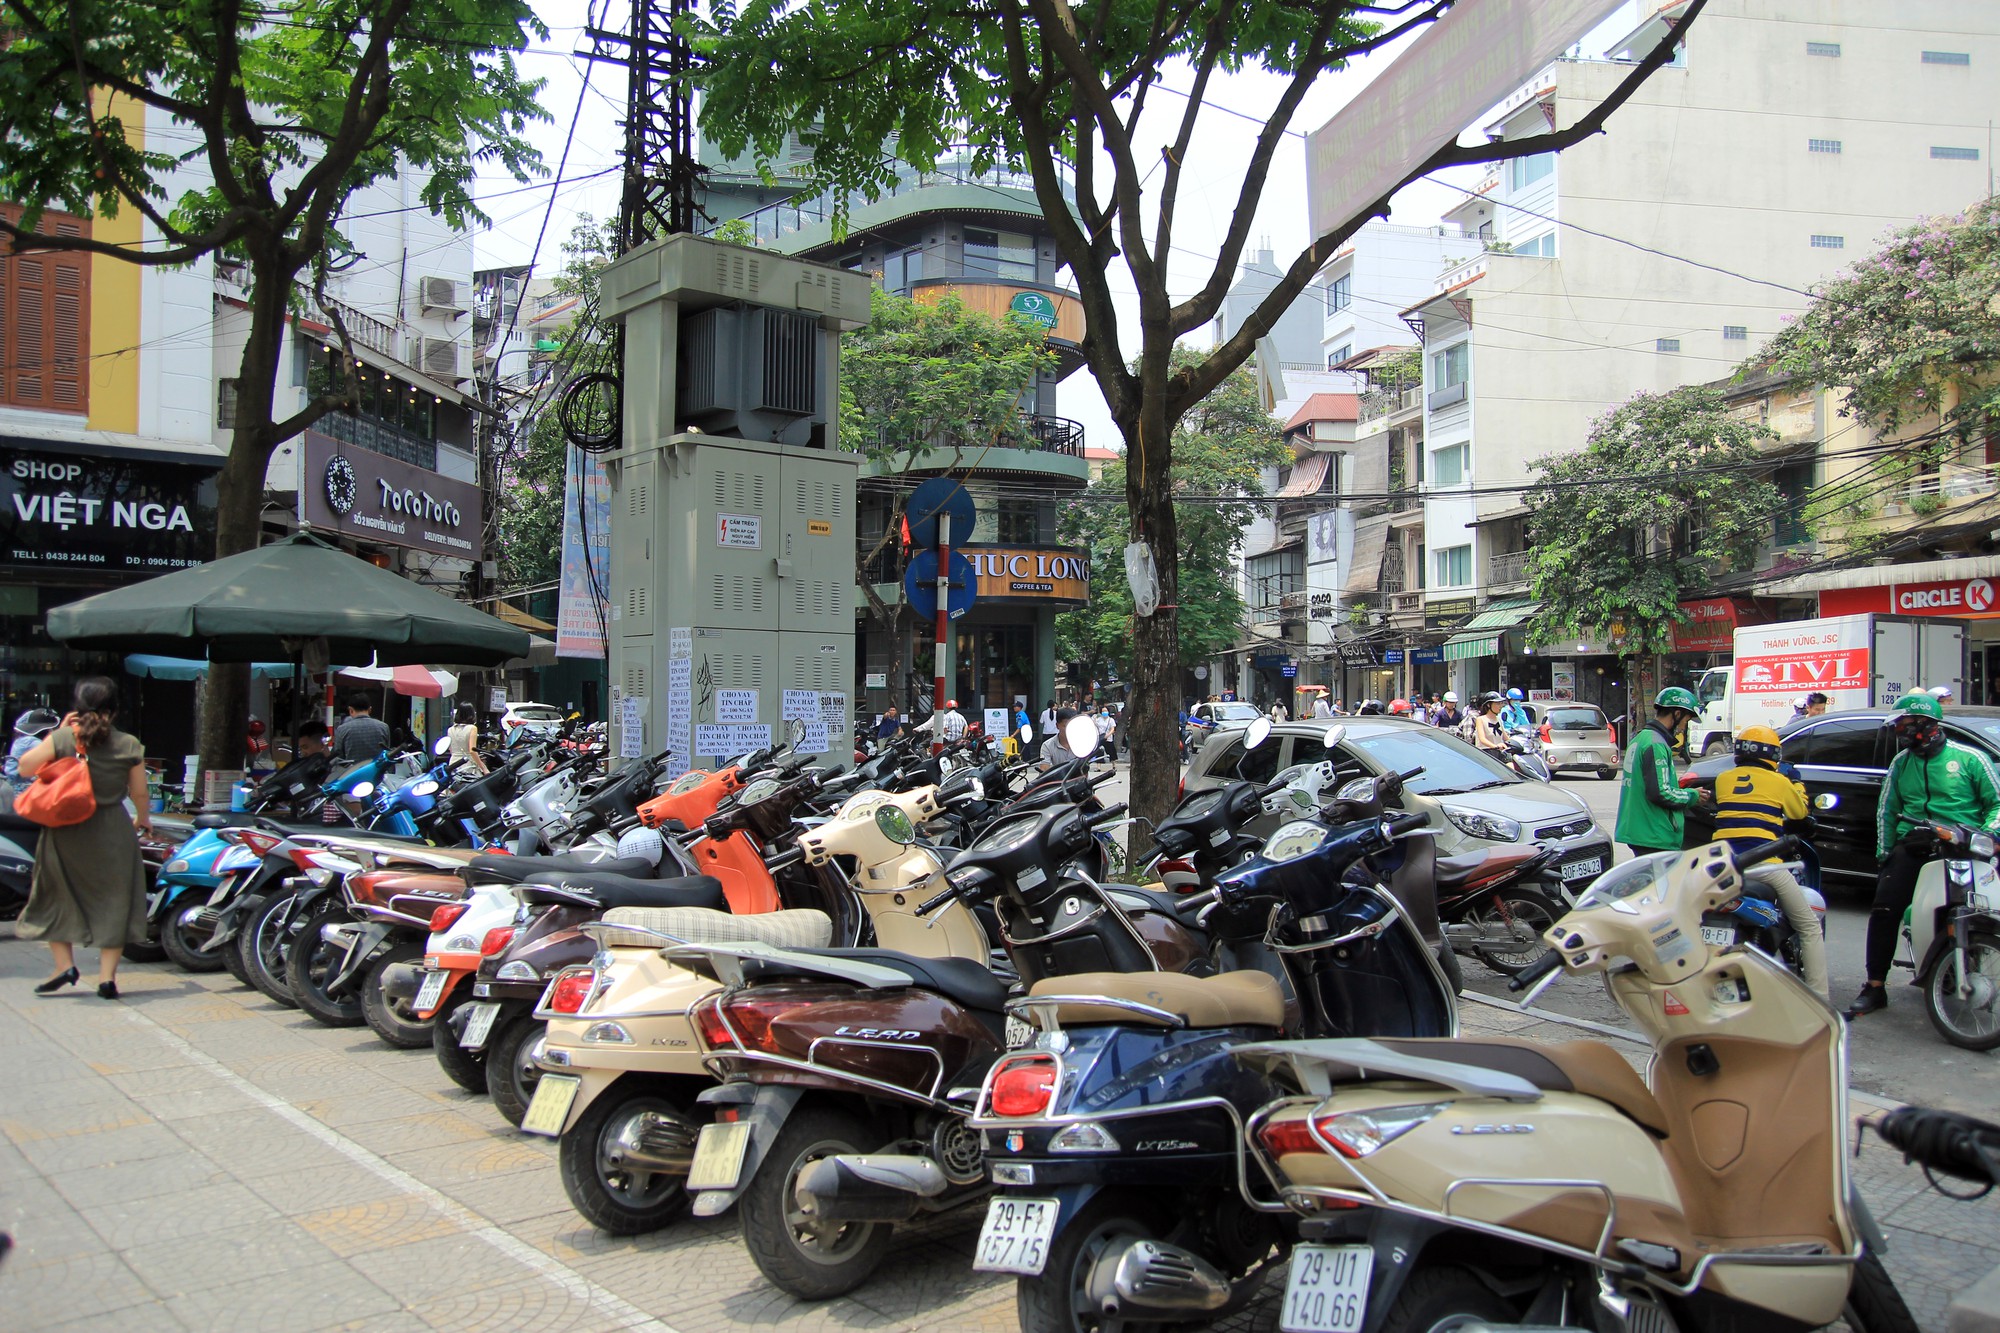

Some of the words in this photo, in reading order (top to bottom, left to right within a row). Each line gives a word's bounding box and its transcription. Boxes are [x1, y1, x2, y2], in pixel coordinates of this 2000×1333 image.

[13, 460, 82, 481] SHOP
[12, 491, 102, 531] VIỆT
[113, 501, 194, 532] NGA
[13, 551, 38, 559] TELL
[46, 552, 68, 561] 0438
[148, 558, 168, 566] 0904
[170, 559, 186, 567] 206
[962, 554, 1029, 578] HUC
[1036, 555, 1089, 582] LONG
[1900, 587, 1961, 609] CIRCLE
[1971, 585, 1990, 609] K
[1698, 605, 1725, 617] Minh
[1763, 637, 1789, 649] THÀNH
[1822, 634, 1838, 644] JSC
[1774, 658, 1862, 682] TVL
[1741, 681, 1828, 691] TRANSPORT
[1887, 682, 1901, 692] 29H
[821, 693, 831, 706] SỬA
[1672, 695, 1690, 705] Grab
[1761, 699, 1786, 708] Hotline:
[1910, 702, 1931, 711] Grab
[811, 722, 824, 730] VAY
[1741, 741, 1758, 752] be
[835, 1026, 921, 1040] LEAD
[651, 1039, 668, 1047] LX
[1450, 1123, 1536, 1136] LEAD
[1136, 1140, 1157, 1151] LX
[993, 1203, 1045, 1234] 29-F1
[980, 1235, 1044, 1268] 157.15
[1290, 1291, 1358, 1329] 140.66
